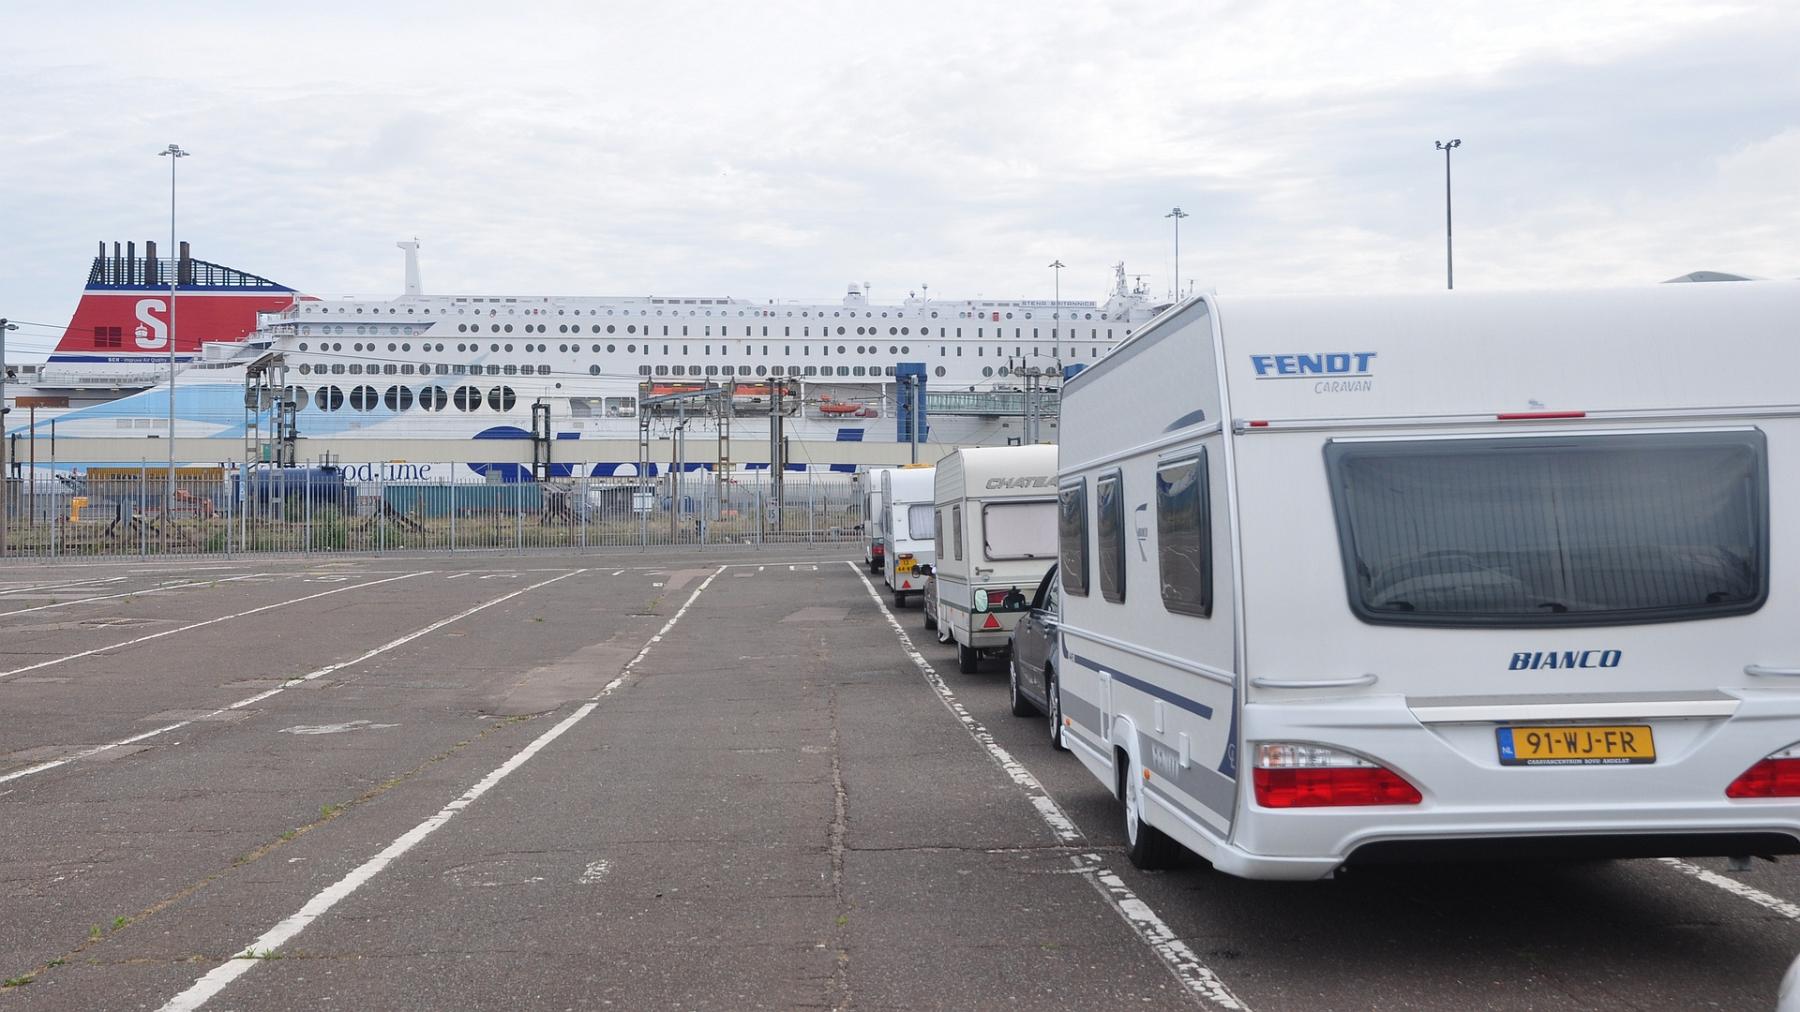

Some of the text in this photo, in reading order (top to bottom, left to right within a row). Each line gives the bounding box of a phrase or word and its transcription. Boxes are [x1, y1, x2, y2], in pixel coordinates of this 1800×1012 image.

[135, 299, 168, 349] S
[1250, 351, 1377, 375] FENDT
[1314, 380, 1372, 394] CARAVAN
[1507, 650, 1623, 671] BIANCO
[1526, 731, 1637, 754] 91-WJ-FR
